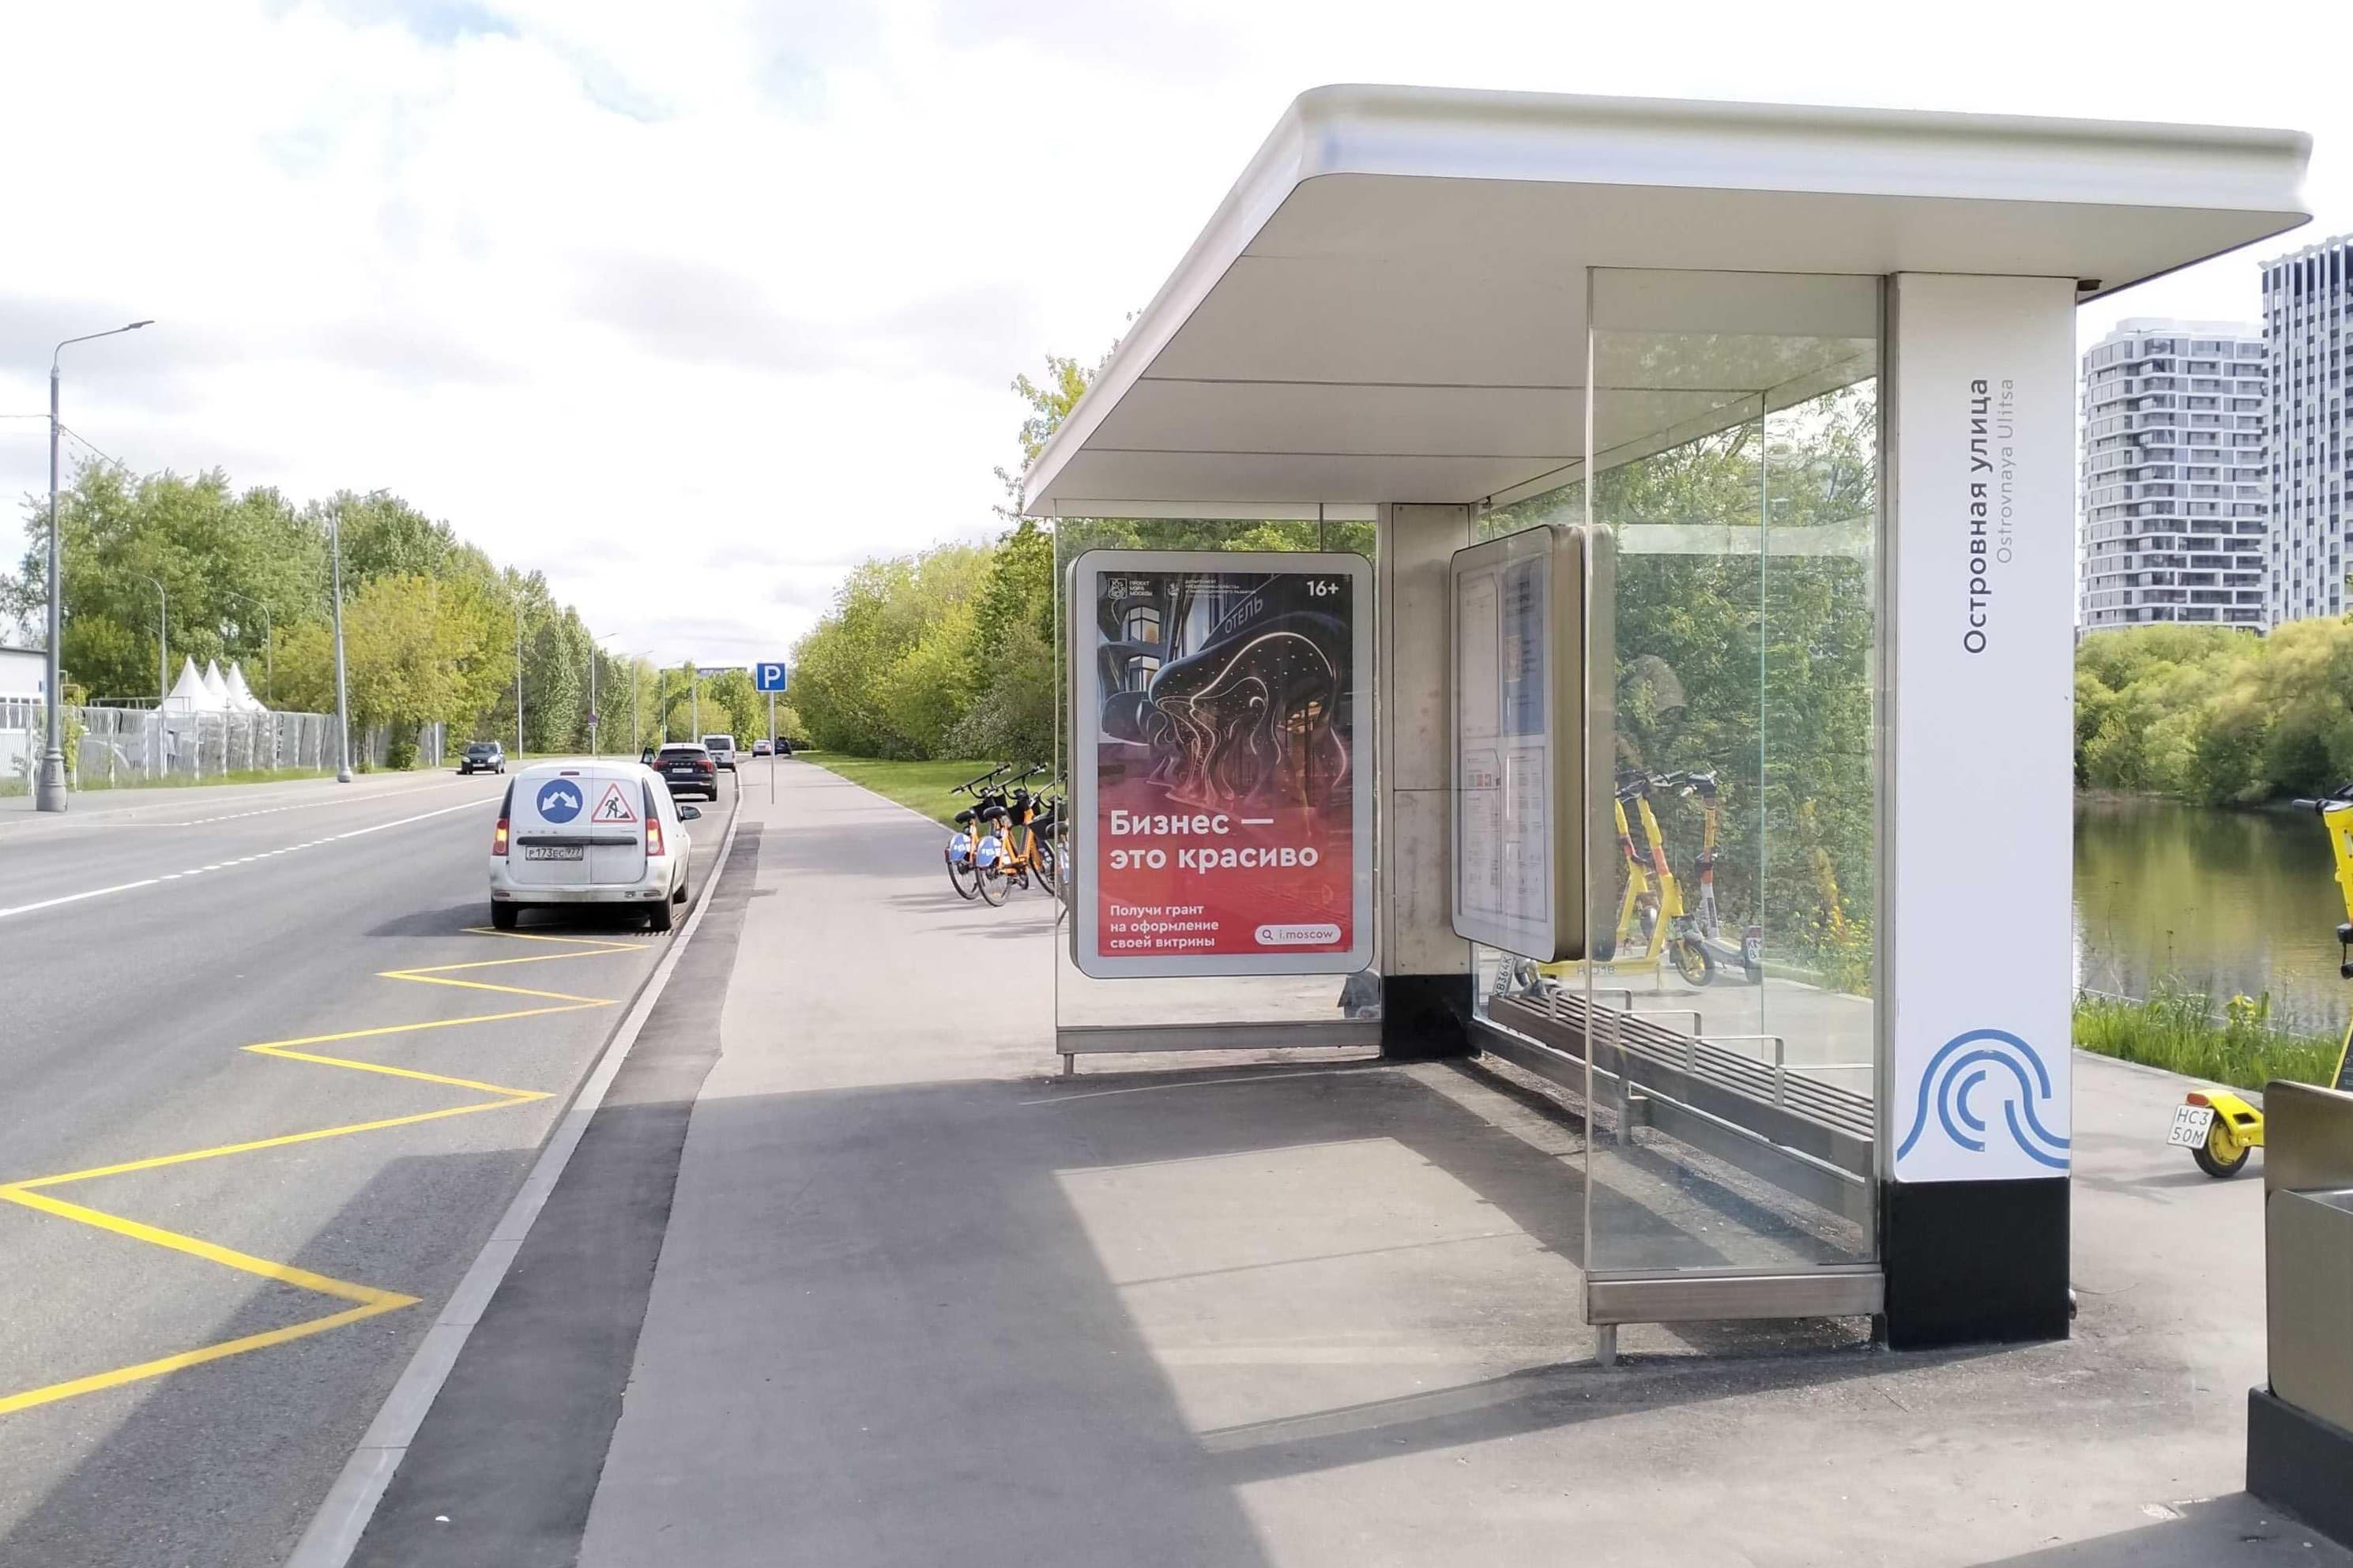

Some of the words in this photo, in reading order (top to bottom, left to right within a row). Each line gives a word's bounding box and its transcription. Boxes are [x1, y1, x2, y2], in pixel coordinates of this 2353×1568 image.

[1997, 379, 2014, 438] Ulitsa
[1971, 379, 1993, 473] улица
[1997, 446, 2017, 563] Ostrovnaya
[1963, 482, 1992, 653] Островная
[1306, 581, 1339, 596] 16+
[1225, 596, 1264, 634] ОТЕЛЬ
[764, 665, 781, 689] P
[1110, 810, 1229, 835] Бизнес
[1110, 848, 1167, 869] это
[1179, 847, 1319, 874] красиво
[1110, 904, 1161, 919] Получи
[1165, 905, 1205, 919] грант
[1110, 922, 1127, 933] на
[1131, 919, 1219, 934] оформление
[1279, 929, 1333, 940] i.moscow
[1110, 936, 1152, 949] своей
[1157, 938, 1215, 950] витрины
